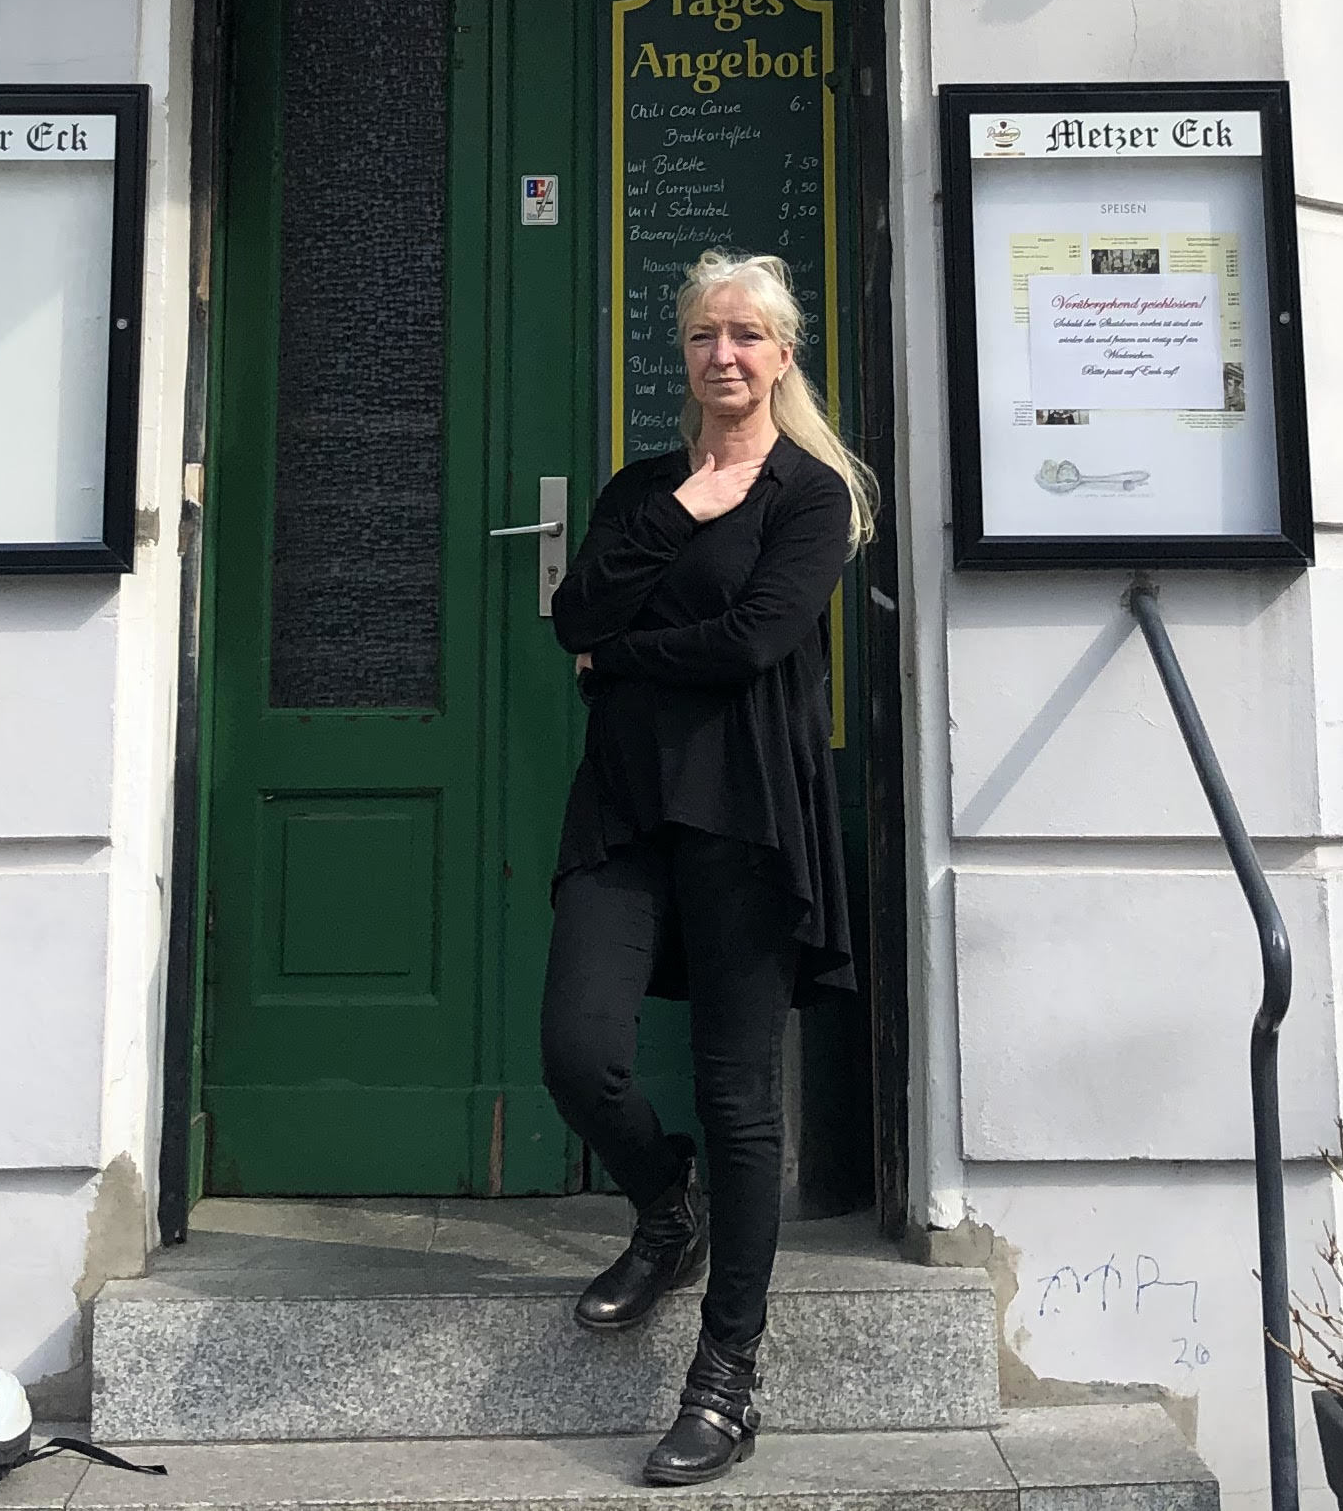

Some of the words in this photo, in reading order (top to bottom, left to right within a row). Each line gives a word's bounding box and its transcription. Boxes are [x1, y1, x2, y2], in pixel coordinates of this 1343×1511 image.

[630, 38, 819, 94] Angebot
[630, 101, 665, 120] Chili
[26, 121, 89, 152] Eck
[1046, 119, 1159, 154] Metzer
[1172, 118, 1234, 149] Eck
[627, 160, 646, 174] mit
[652, 154, 707, 175] Bulette
[627, 179, 650, 197] mit
[655, 178, 725, 202] Currywurst
[628, 202, 657, 217] mit
[1100, 203, 1147, 215] SPEISEN
[628, 286, 648, 301] mit
[630, 305, 649, 321] mit
[631, 326, 653, 340] mit
